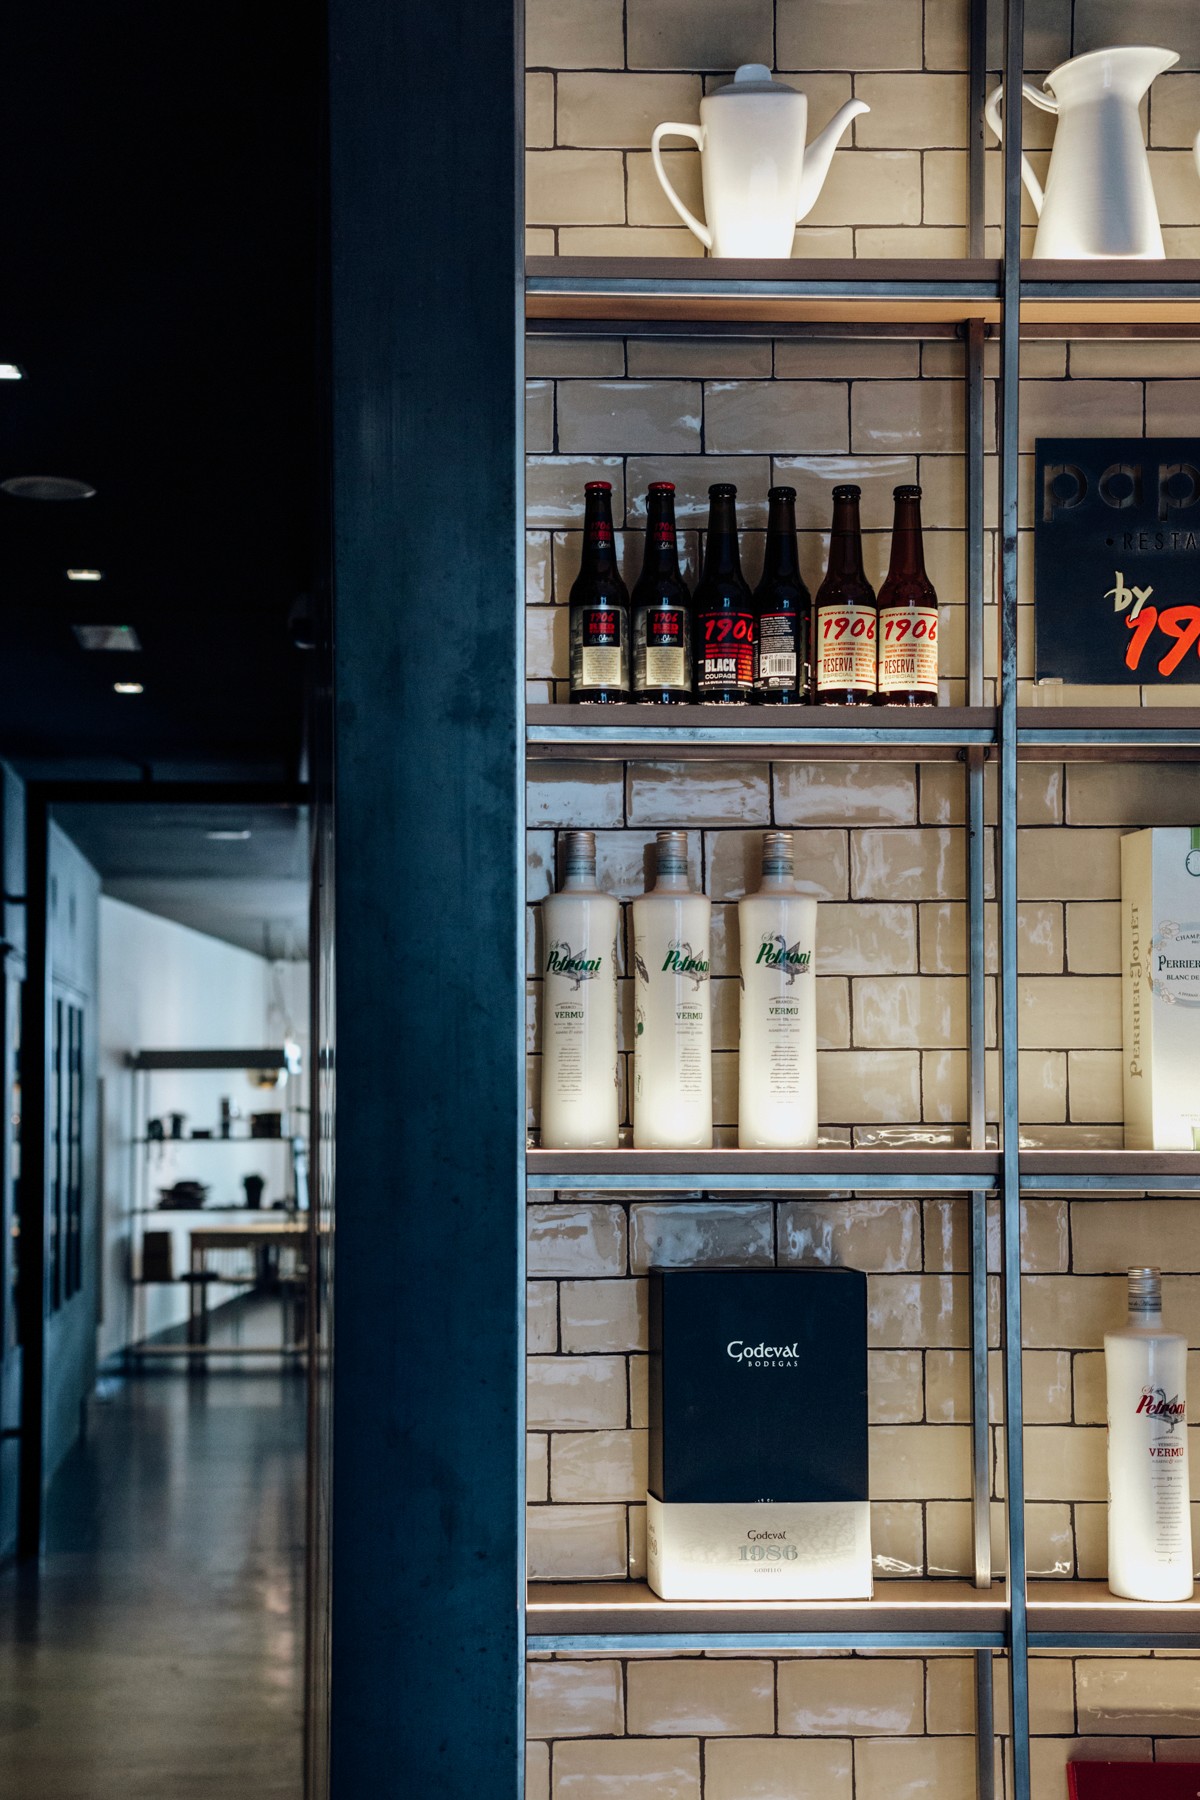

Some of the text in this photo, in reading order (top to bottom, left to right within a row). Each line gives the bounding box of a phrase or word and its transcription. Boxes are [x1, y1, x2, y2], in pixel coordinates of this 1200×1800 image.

[1123, 532, 1197, 550] RESTA
[1103, 570, 1154, 622] by
[590, 612, 615, 622] 1906
[654, 612, 679, 623] 1906
[823, 617, 876, 641] 1906
[884, 618, 937, 641] 1906
[1125, 605, 1200, 676] 19
[704, 658, 737, 673] BLACK
[823, 657, 854, 673] RESERVA
[884, 658, 915, 674] RESERVA
[546, 950, 602, 972] Petroni
[755, 942, 811, 964] Petroni
[1158, 954, 1200, 972] PERRIER
[554, 1011, 584, 1019] VERMU
[676, 1012, 704, 1020] VERMU
[768, 1007, 799, 1015] VERMU
[726, 1340, 800, 1363] Godeval
[747, 1360, 798, 1368] BODEGAS
[1135, 1394, 1186, 1415] Petroni
[1148, 1447, 1185, 1457] VERMU
[747, 1529, 787, 1542] Godeval
[738, 1544, 798, 1561] 1986
